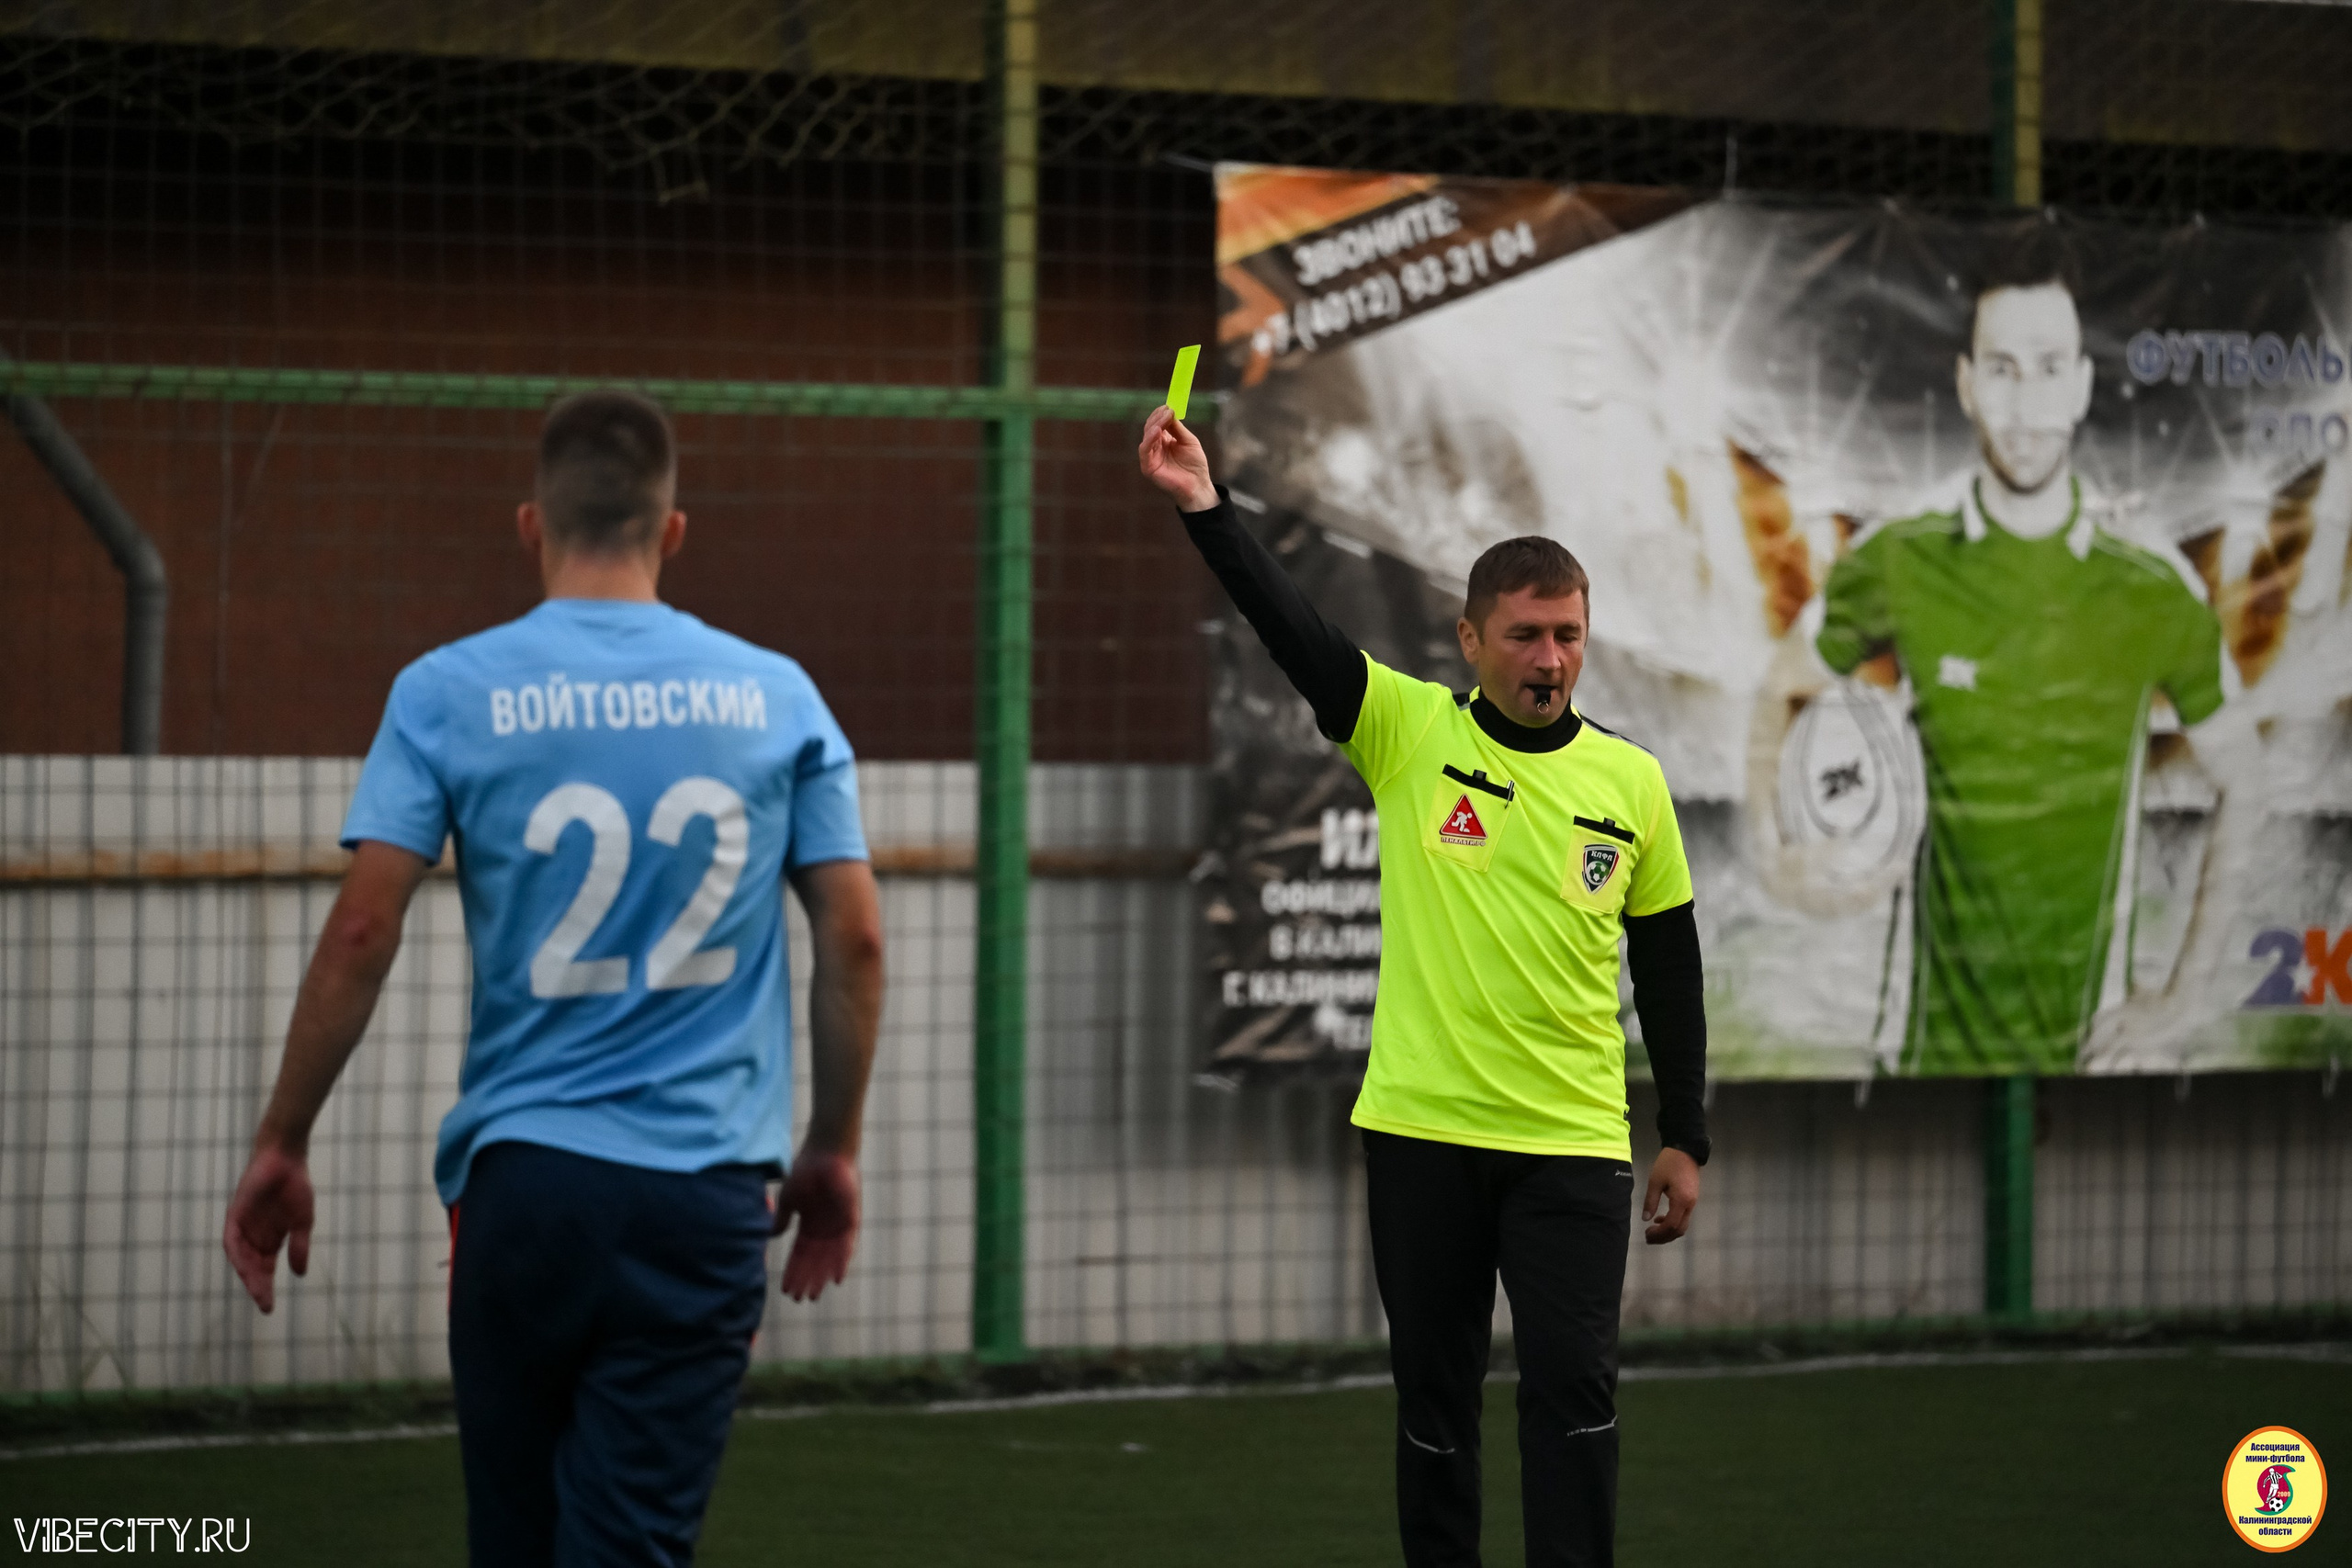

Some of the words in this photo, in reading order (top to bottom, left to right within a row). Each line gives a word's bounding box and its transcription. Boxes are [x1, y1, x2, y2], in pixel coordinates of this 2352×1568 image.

[2126, 328, 2352, 388] ФУТБОЛЬ
[491, 671, 767, 735] ВОЙТОВСКИЙ
[524, 775, 750, 999] 22
